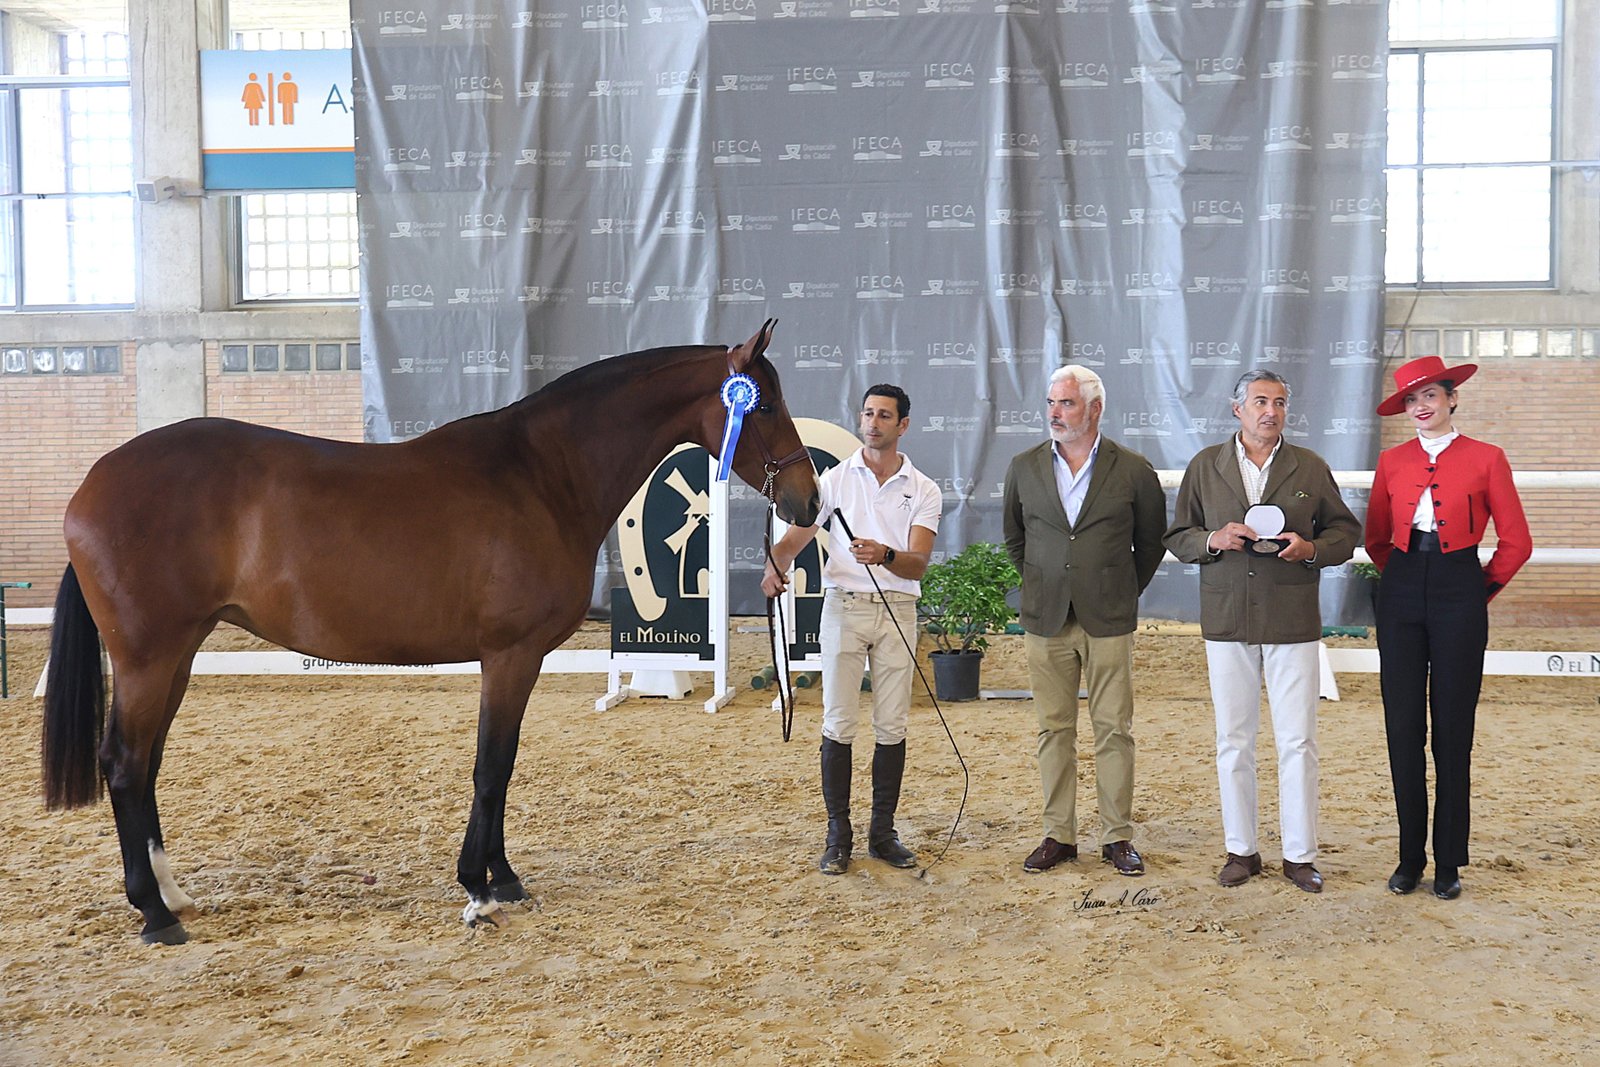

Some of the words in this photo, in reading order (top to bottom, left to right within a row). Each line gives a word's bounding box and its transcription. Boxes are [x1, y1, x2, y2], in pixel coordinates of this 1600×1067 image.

[378, 11, 427, 24] IFECA
[581, 5, 628, 18] IFECA
[1195, 57, 1247, 71] IFECA
[1332, 55, 1384, 68] IFECA
[787, 68, 837, 80] IFECA
[924, 63, 975, 76] IFECA
[1059, 63, 1109, 76] IFECA
[455, 77, 503, 89] IFECA
[322, 84, 354, 114] A
[1264, 126, 1312, 141] IFECA
[712, 140, 761, 153] IFECA
[853, 137, 902, 149] IFECA
[585, 145, 632, 157] IFECA
[926, 204, 975, 217] IFECA
[1059, 205, 1107, 217] IFECA
[1192, 200, 1244, 213] IFECA
[1330, 198, 1382, 211] IFECA
[459, 214, 507, 226] IFECA
[791, 208, 840, 221] IFECA
[856, 276, 904, 288] IFECA
[1261, 270, 1310, 283] IFECA
[386, 285, 434, 297] IFECA
[587, 281, 634, 294] IFECA
[718, 278, 766, 291] IFECA
[794, 346, 843, 357] IFECA
[928, 343, 976, 355] IFECA
[1190, 342, 1241, 355] IFECA
[462, 351, 510, 363] IFECA
[1123, 412, 1172, 425] IFECA
[620, 632, 633, 643] EL
[805, 632, 819, 643] EL
[1568, 661, 1584, 673] EL
